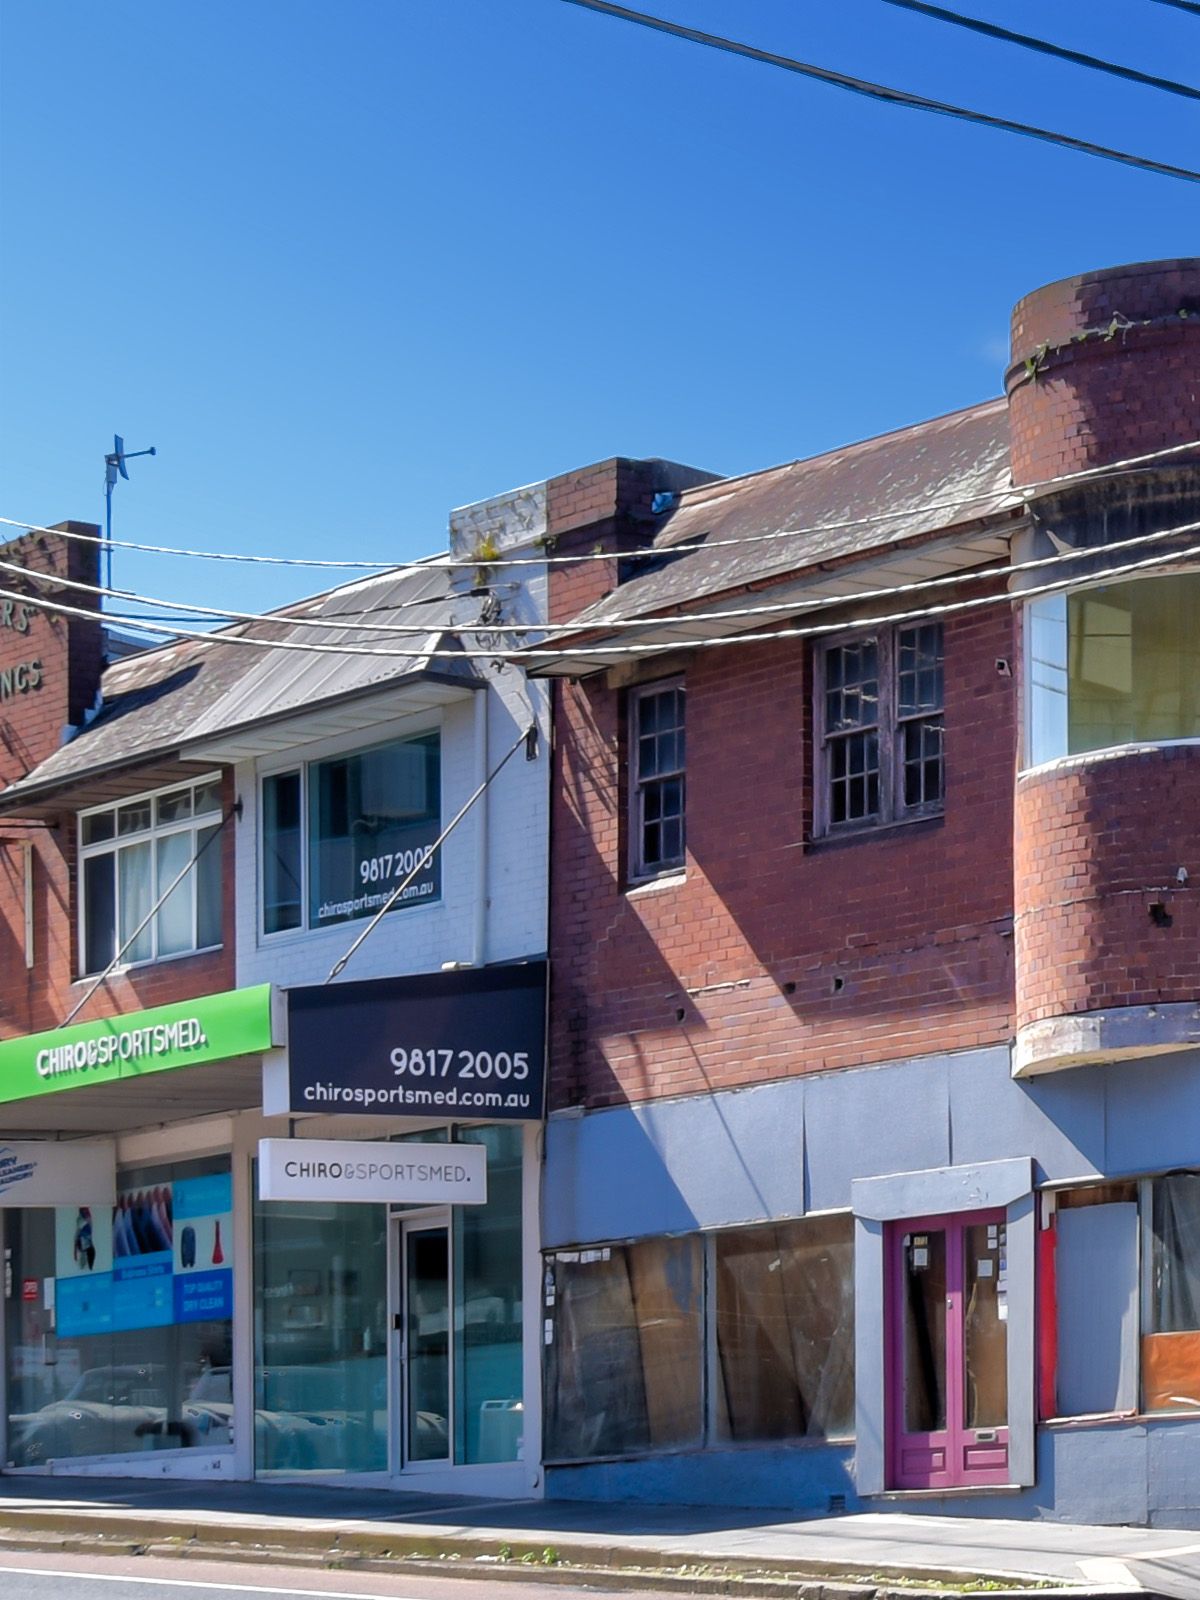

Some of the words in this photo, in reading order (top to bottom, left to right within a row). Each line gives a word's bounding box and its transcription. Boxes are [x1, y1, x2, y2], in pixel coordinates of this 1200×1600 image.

[318, 881, 434, 919] chirosportsmedom.au
[303, 1082, 531, 1107] chirosportsmed.com.au
[284, 1161, 472, 1183] CHIRO&SPORTSMED.
